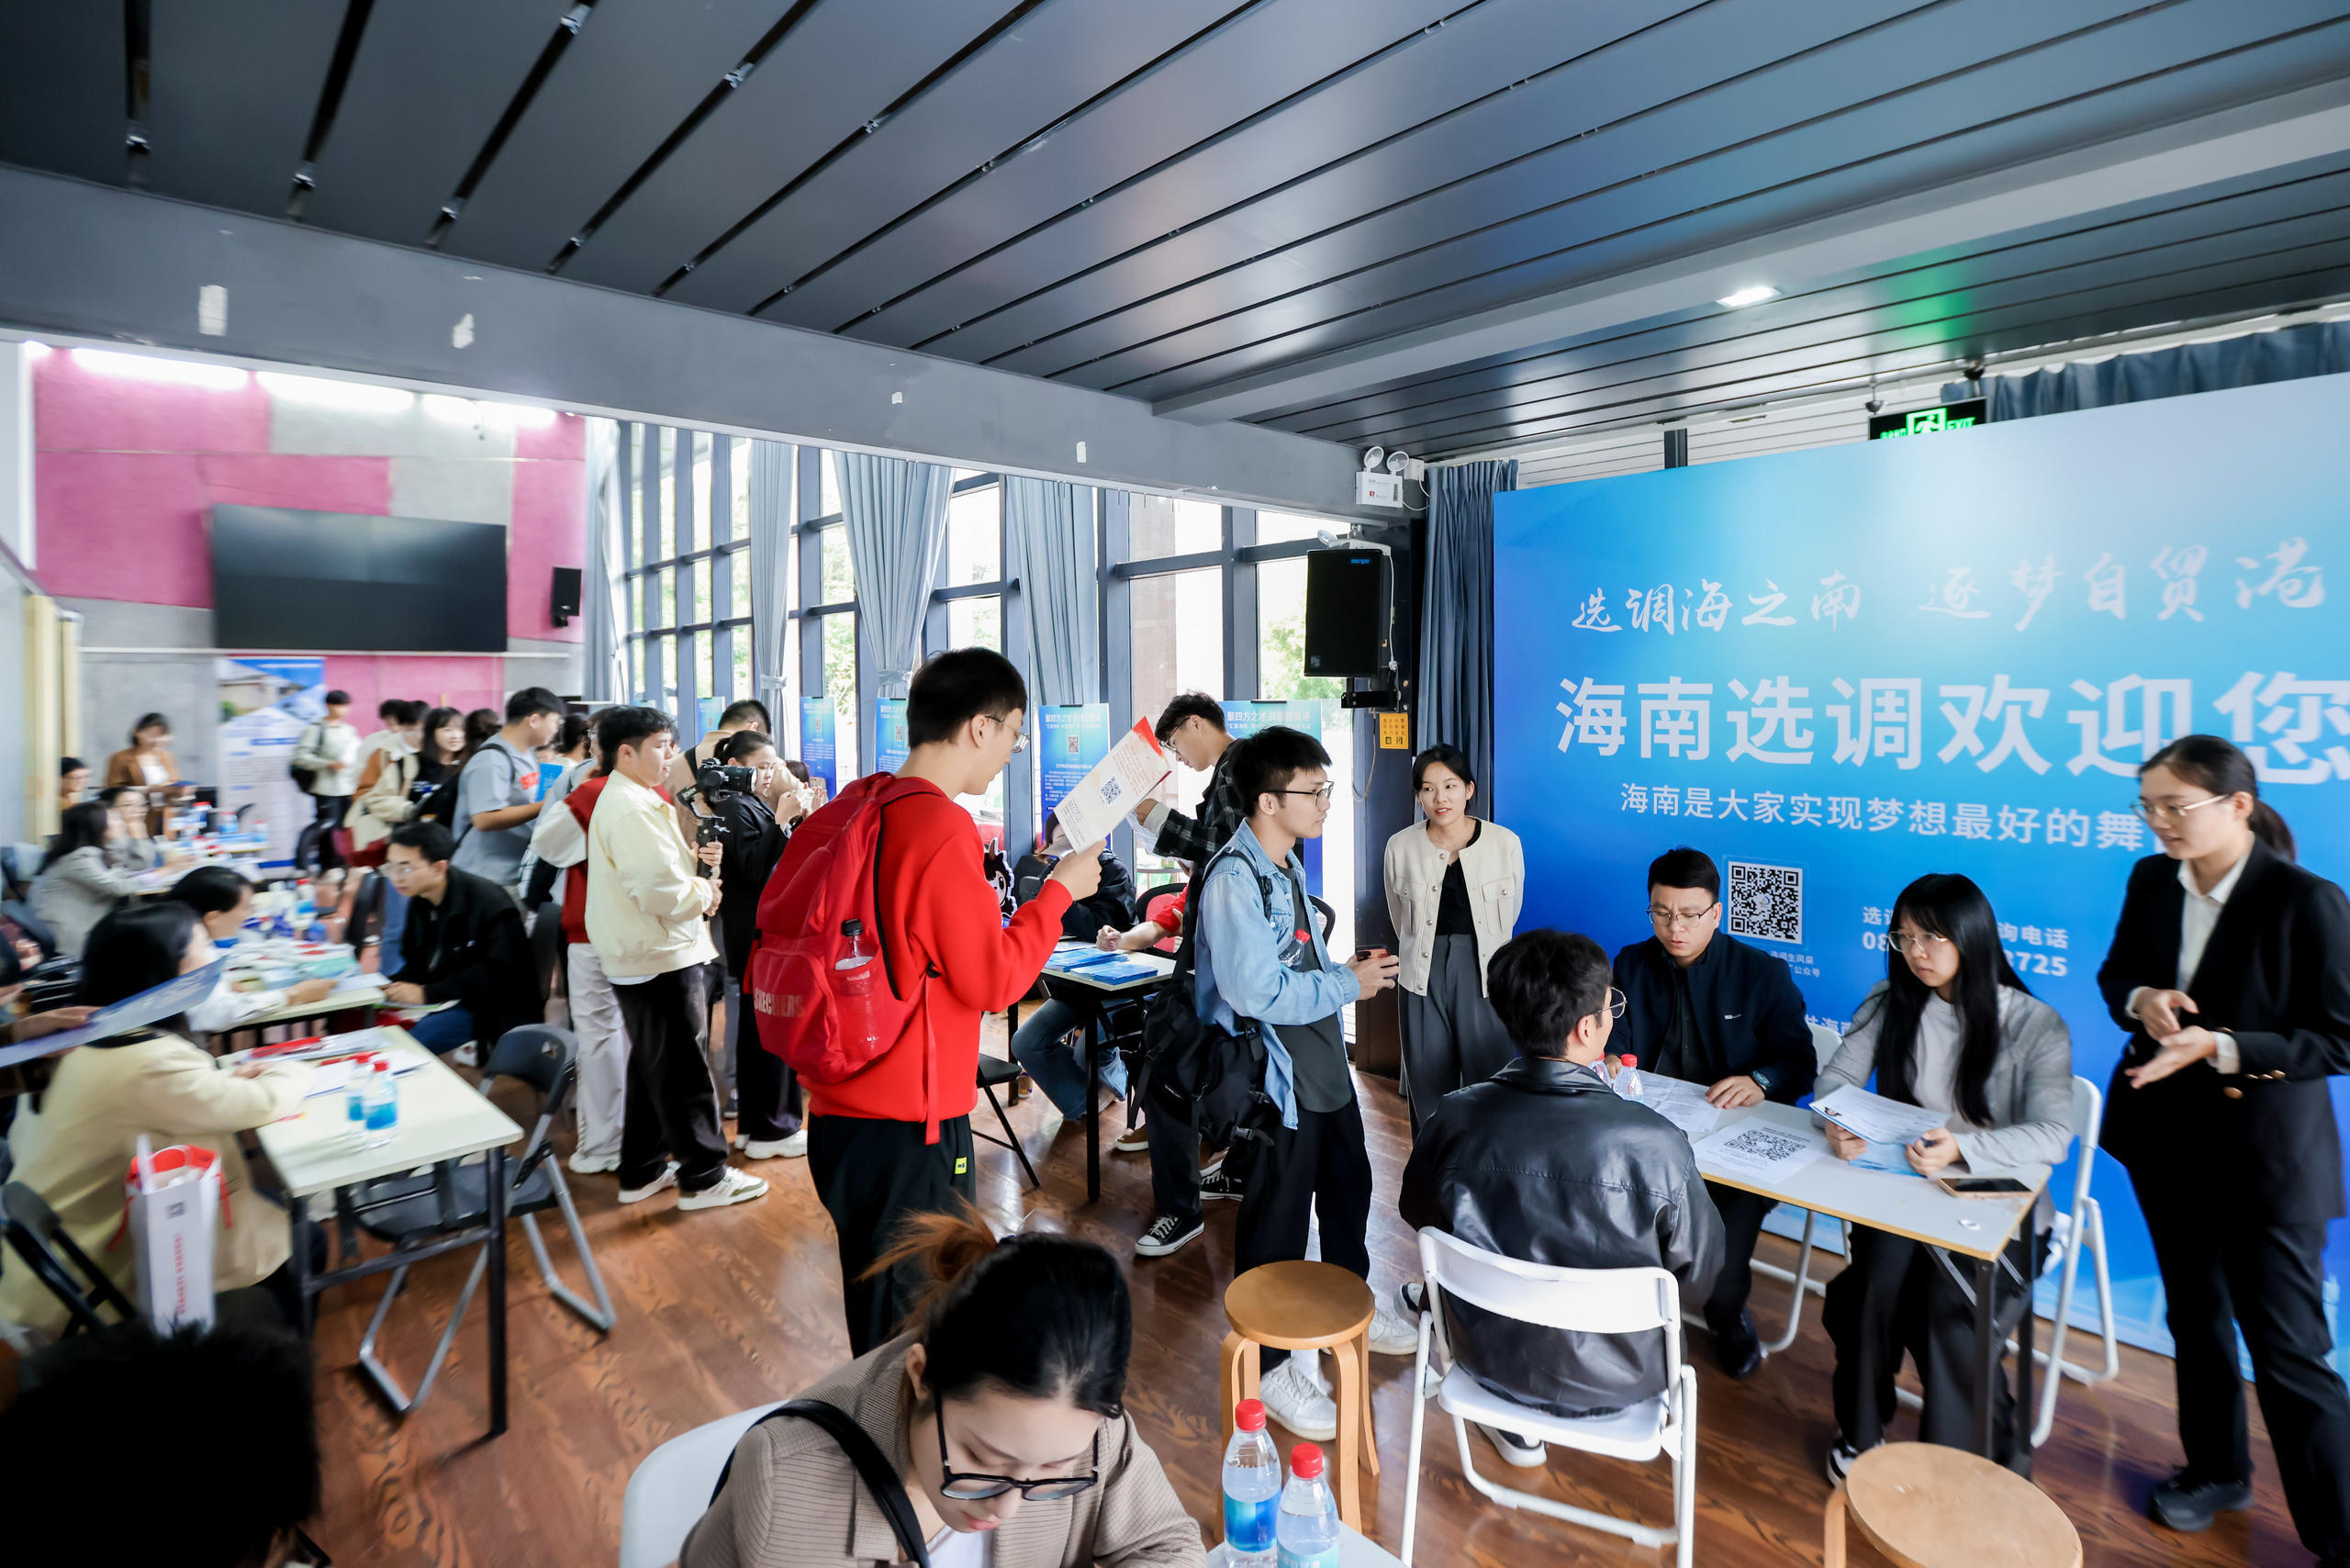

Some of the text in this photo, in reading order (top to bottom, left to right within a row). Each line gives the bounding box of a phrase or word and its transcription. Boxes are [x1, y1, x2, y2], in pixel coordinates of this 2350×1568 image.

[1572, 537, 2325, 635] 选调海之南 逐梦自贸港
[1555, 671, 2350, 784] 海南选调欢迎您
[1620, 783, 2166, 854] 海南是大家实现梦想最好的舞
